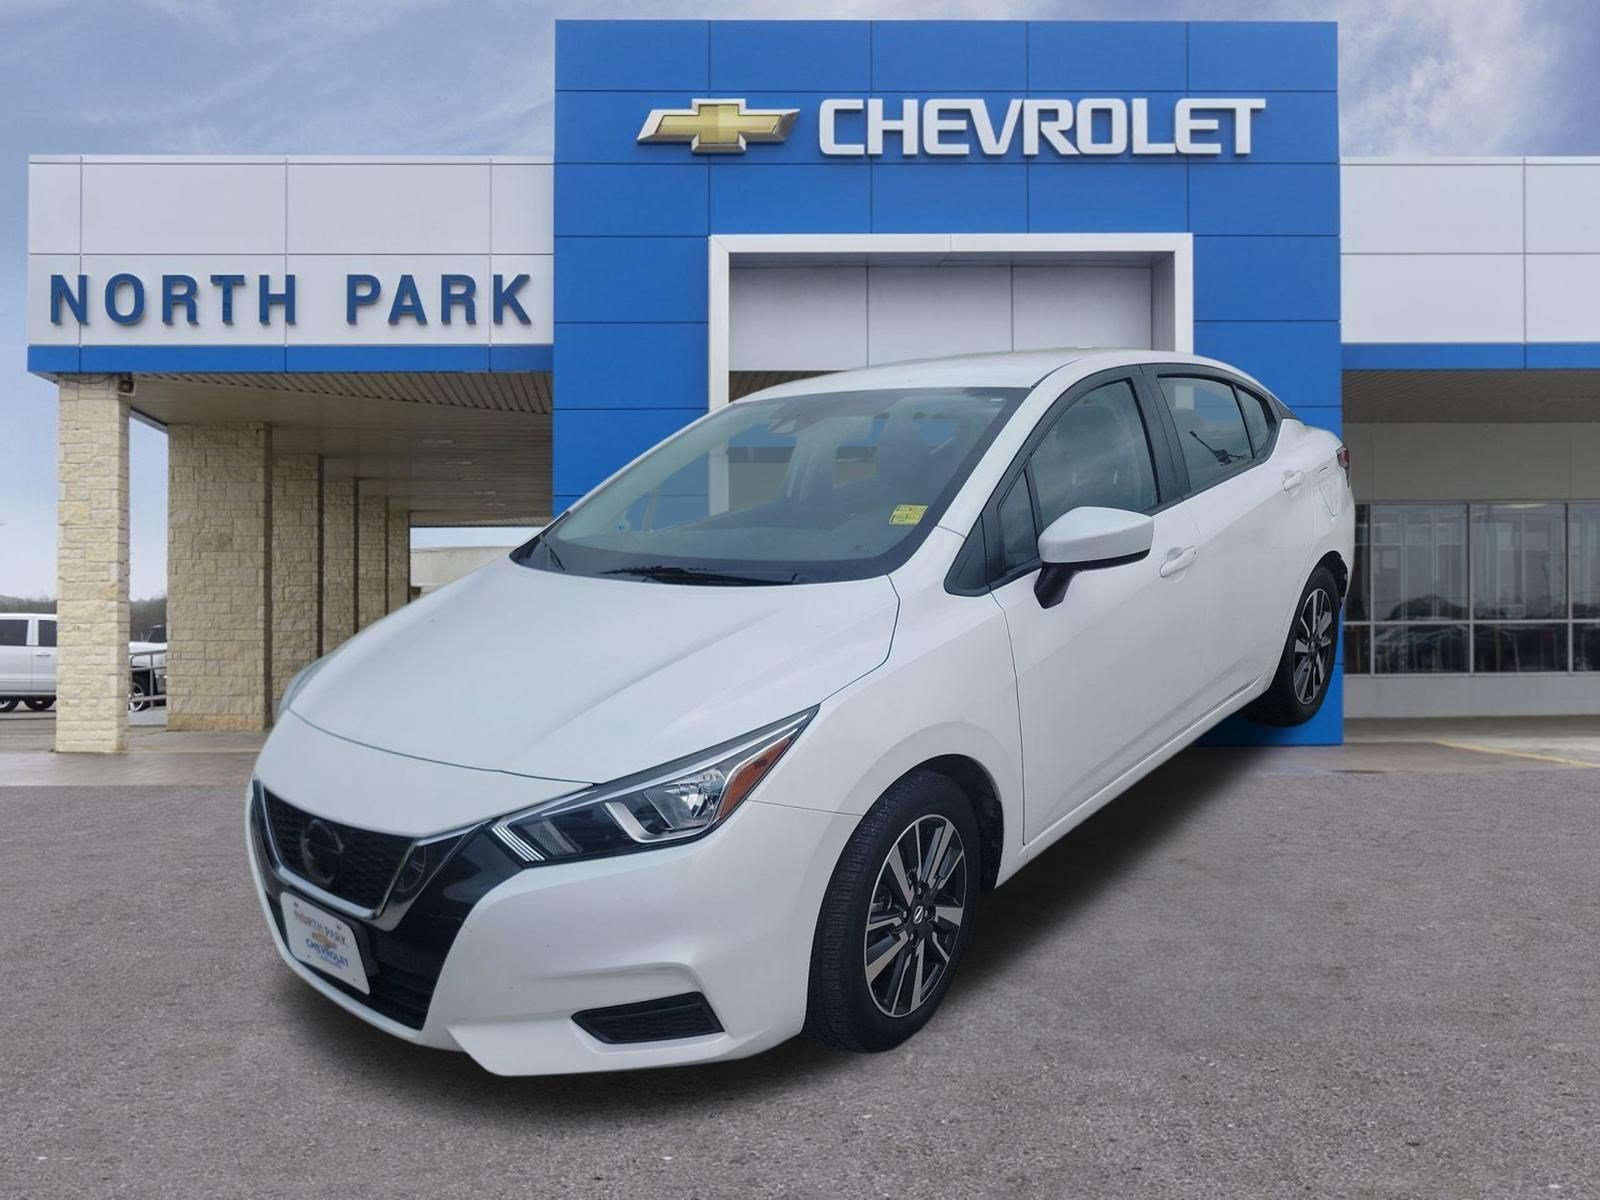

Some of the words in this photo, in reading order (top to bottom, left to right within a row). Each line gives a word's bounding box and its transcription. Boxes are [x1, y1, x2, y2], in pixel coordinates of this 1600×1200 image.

[819, 98, 1267, 157] CHEVROLET
[50, 273, 297, 325] NORTH
[346, 274, 533, 325] PARK
